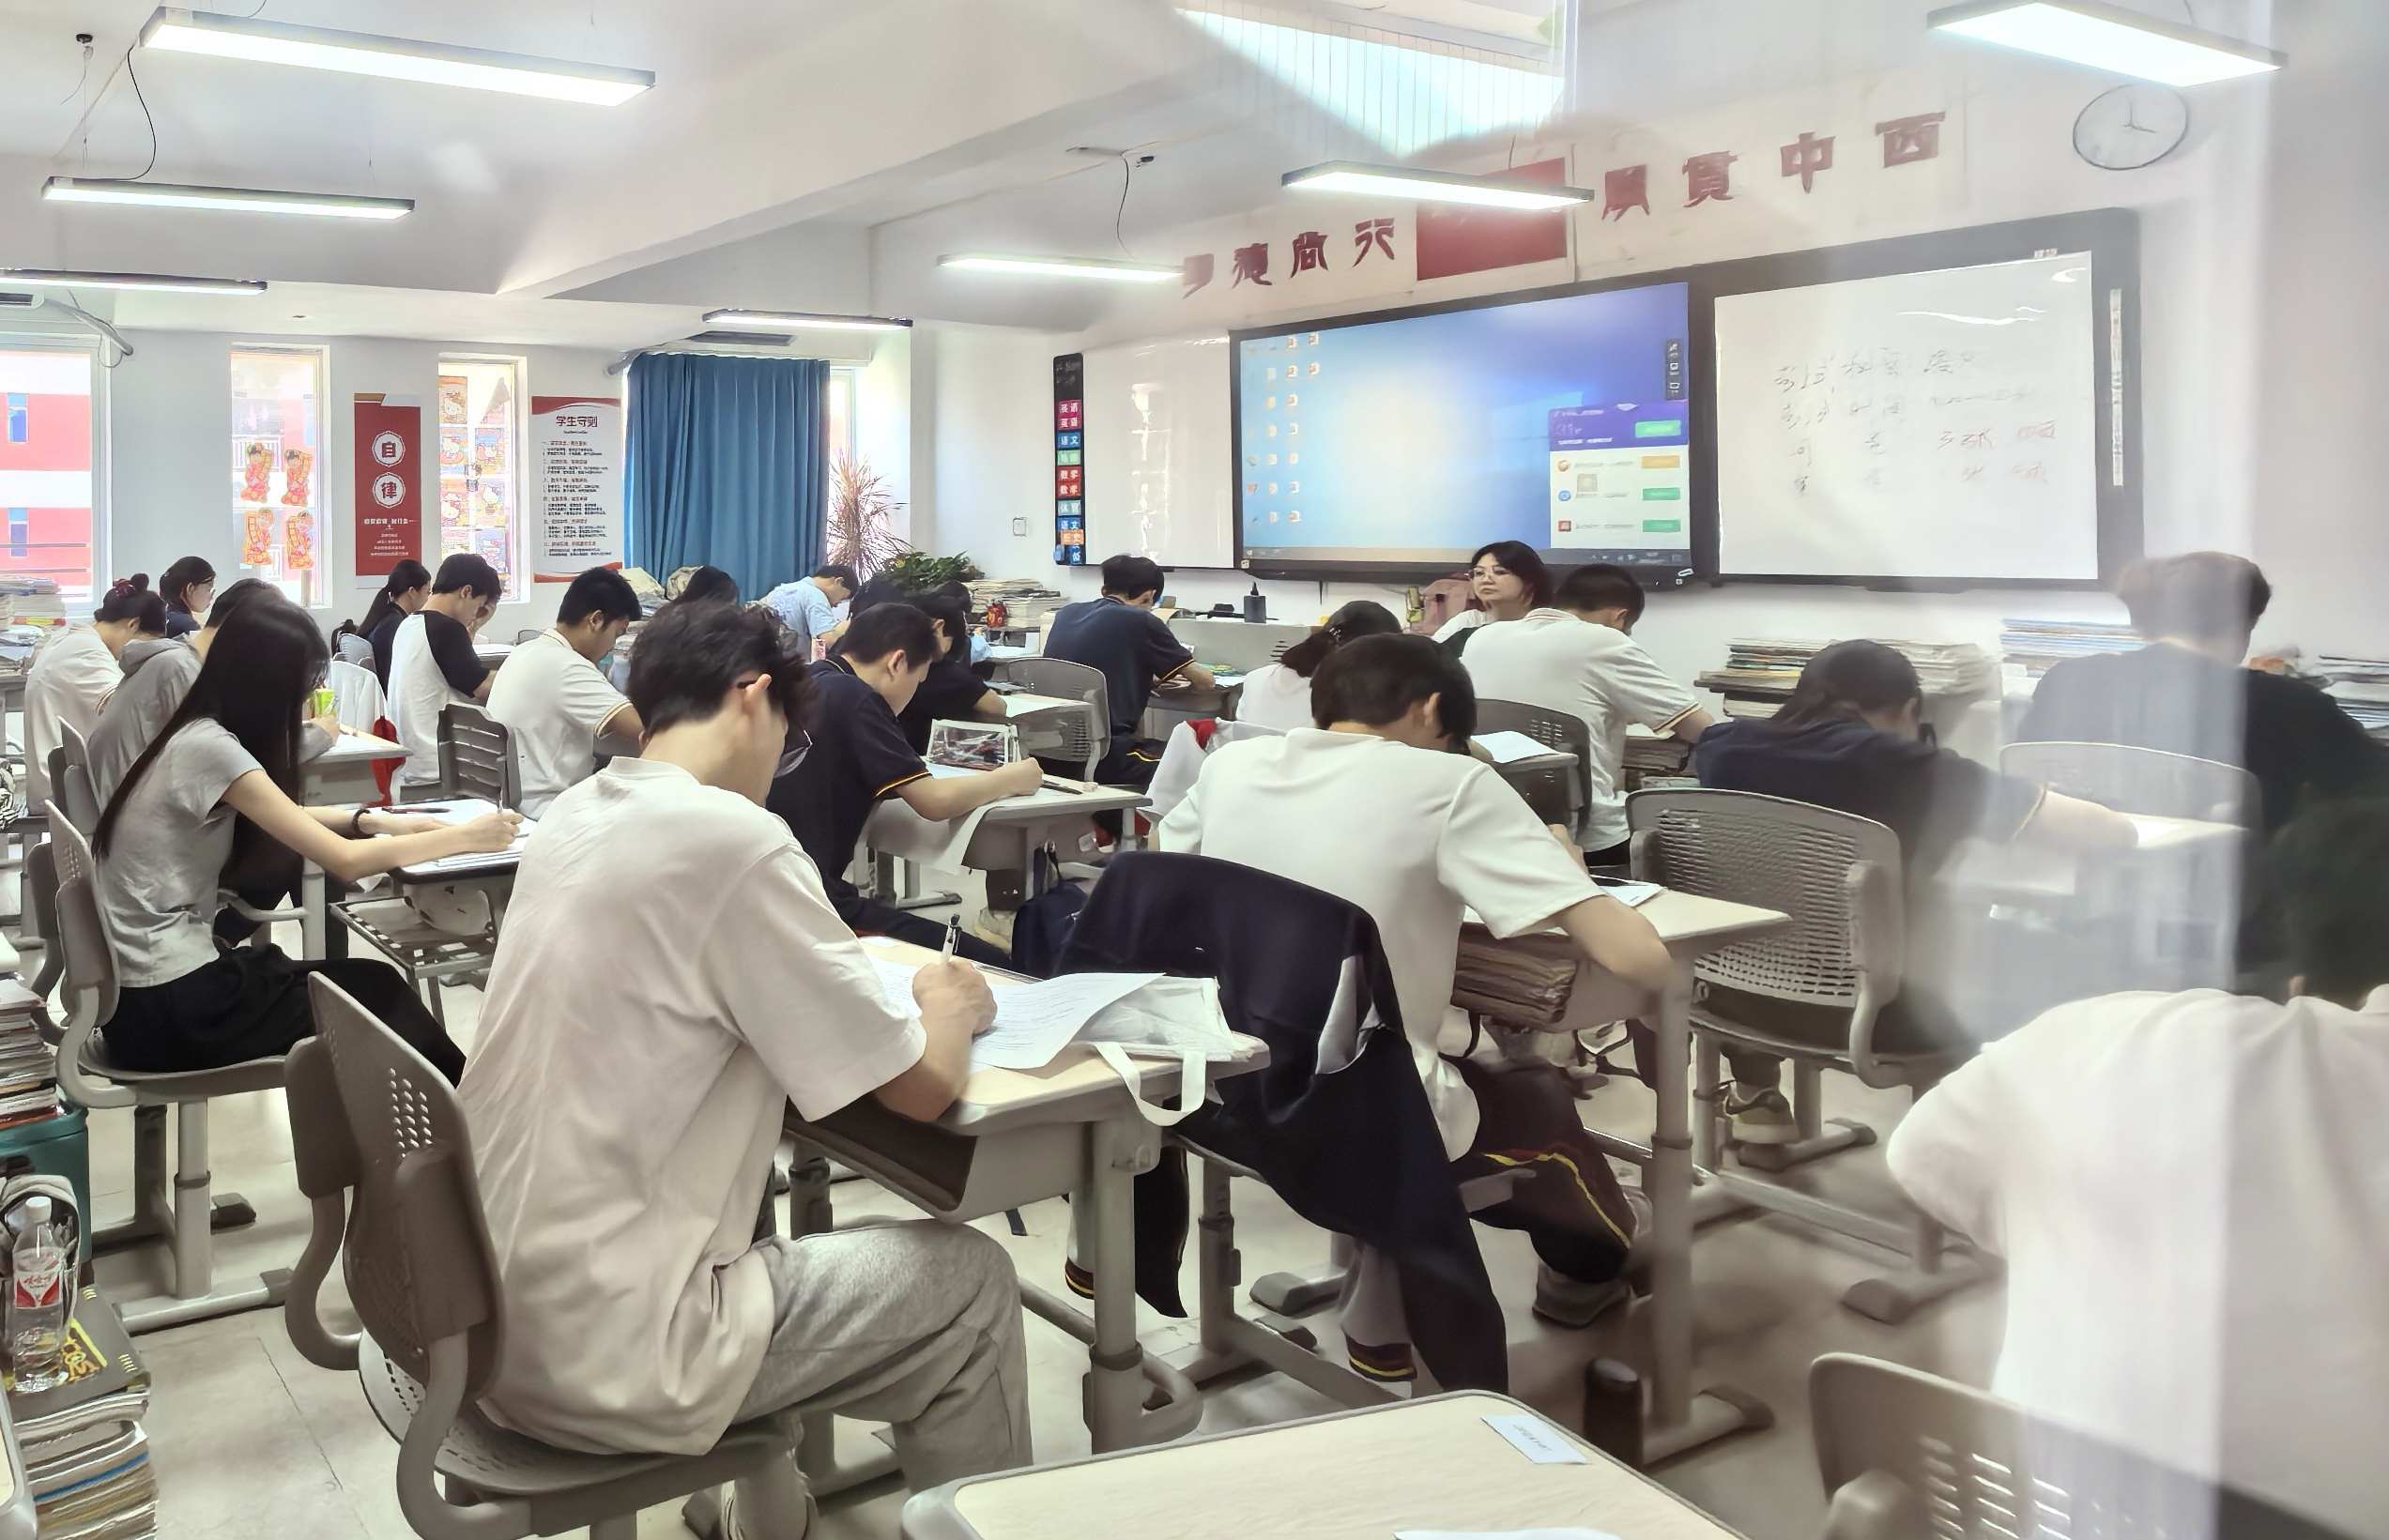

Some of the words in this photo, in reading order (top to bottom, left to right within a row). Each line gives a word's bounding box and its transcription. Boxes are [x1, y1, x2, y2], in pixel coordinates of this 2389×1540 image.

[556, 415, 598, 428] 学生守则
[1061, 435, 1079, 446] 语文
[381, 441, 398, 499] 自律
